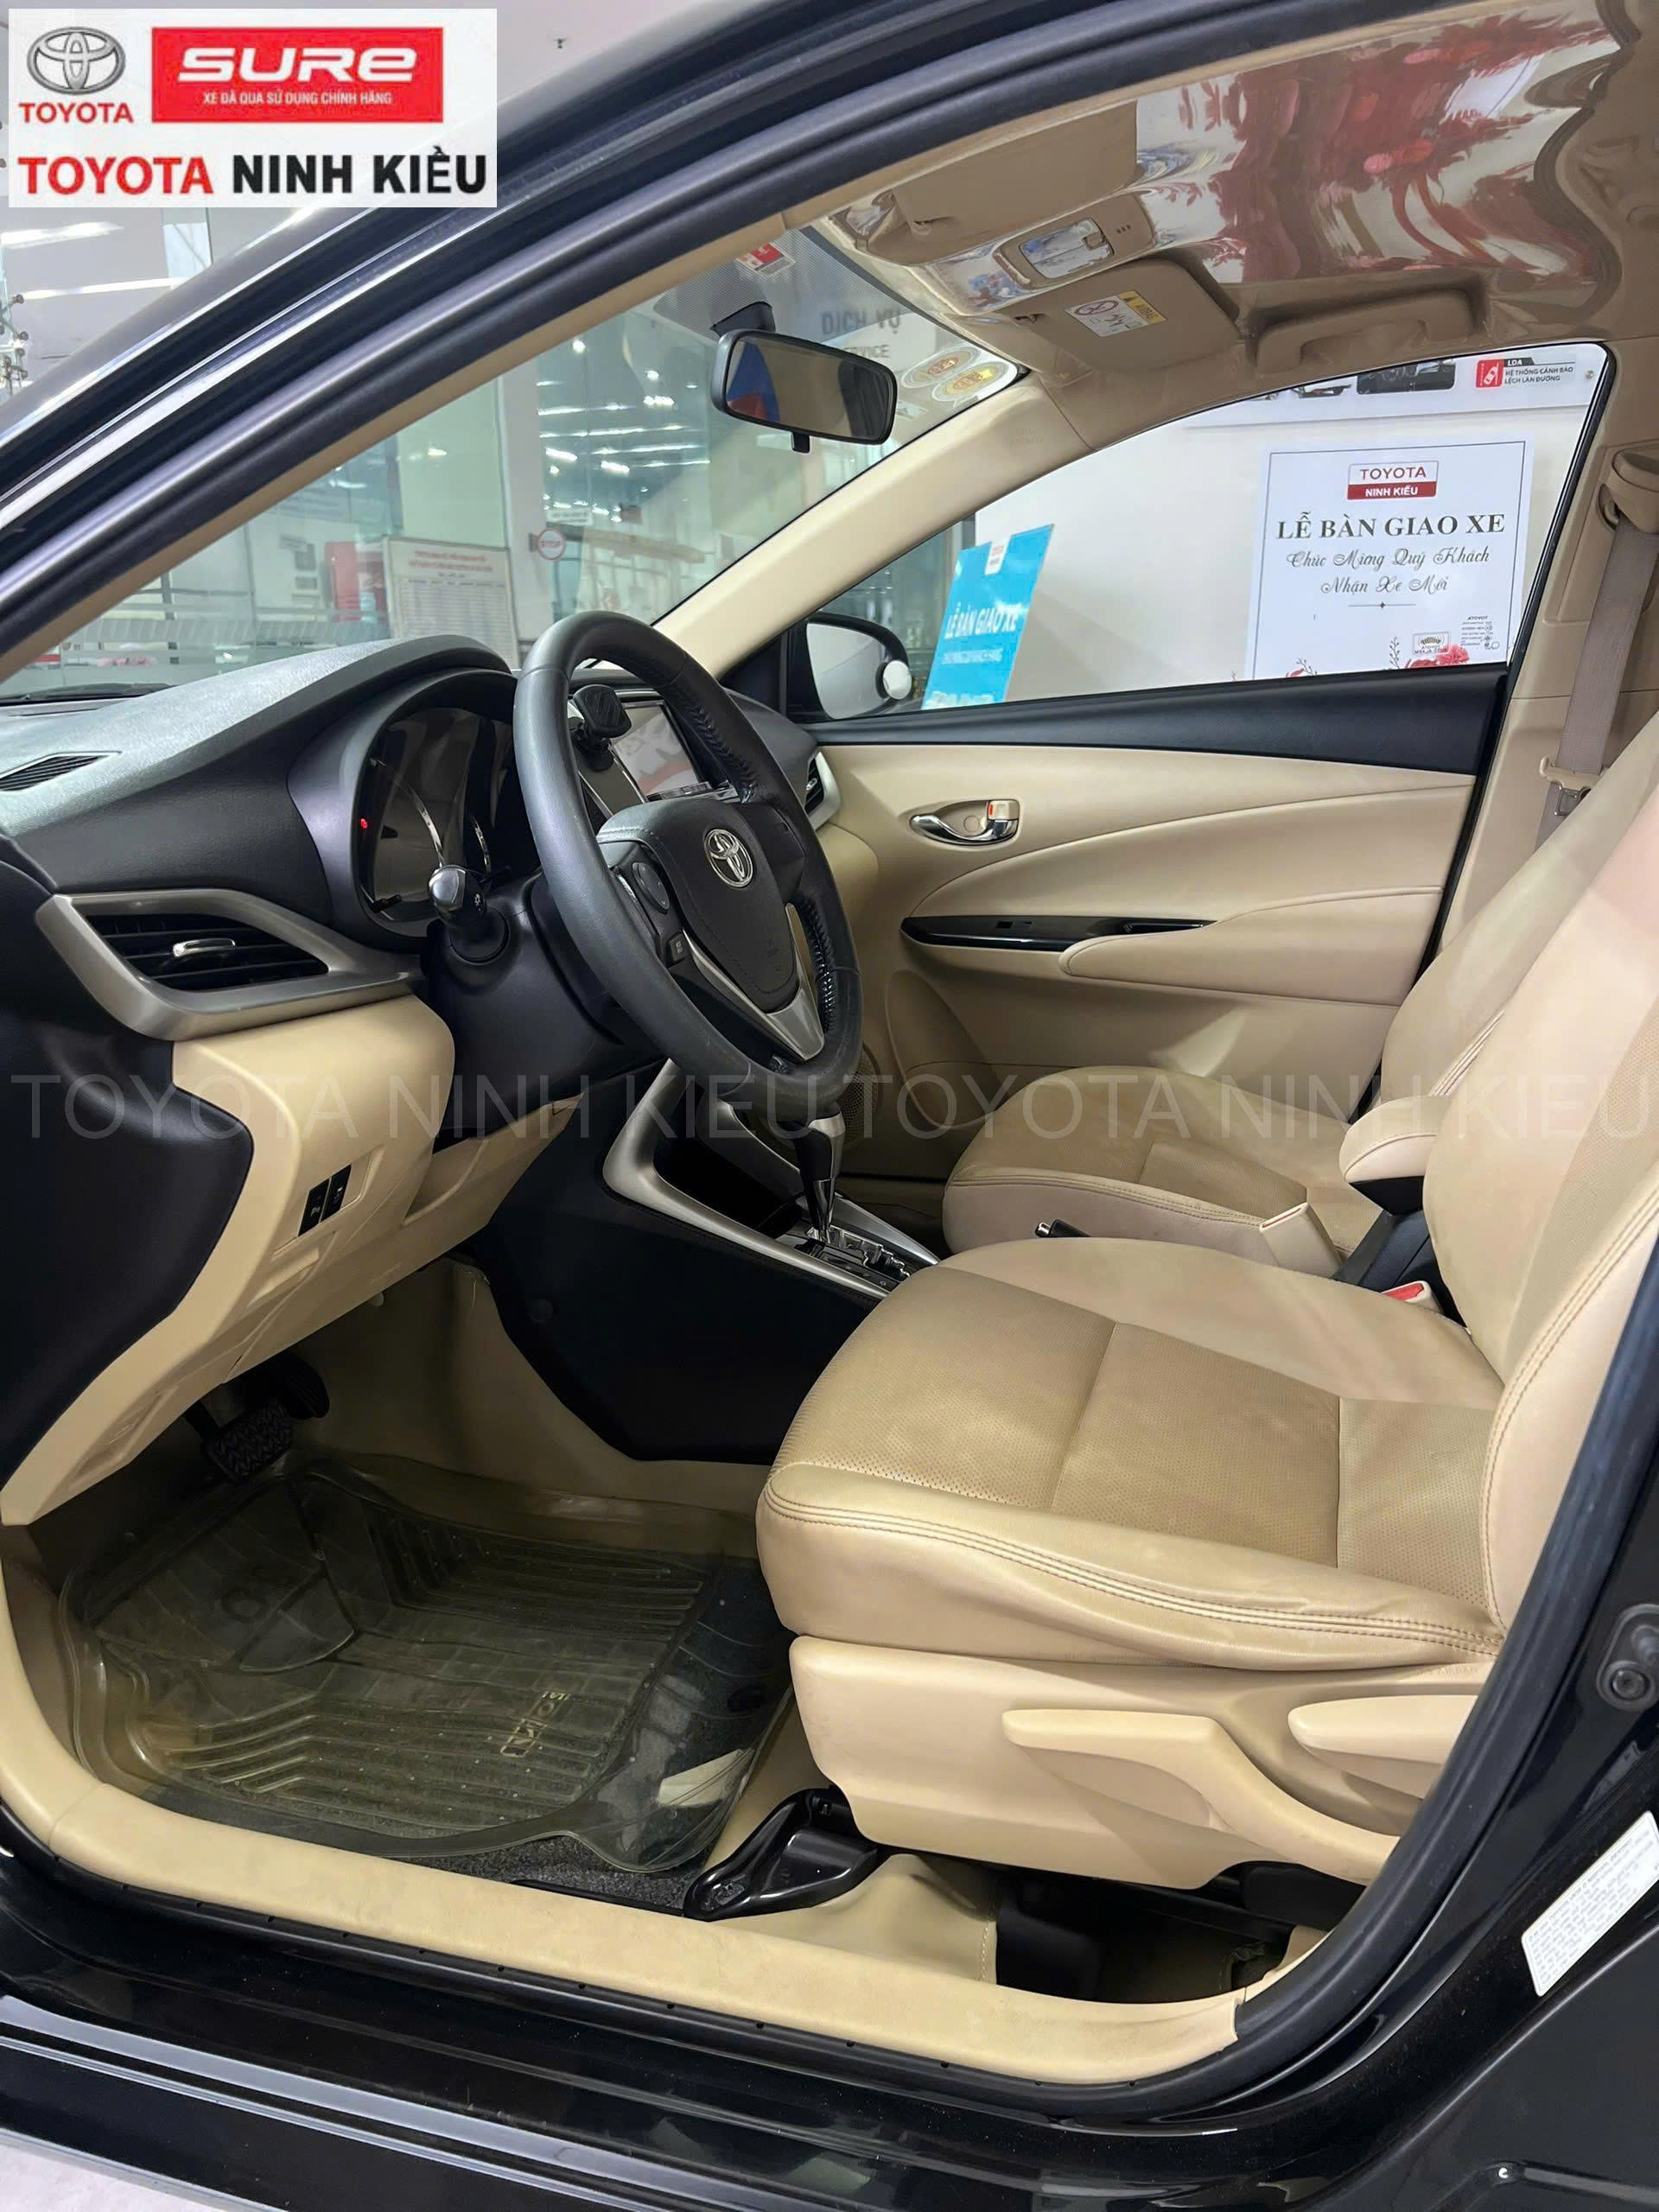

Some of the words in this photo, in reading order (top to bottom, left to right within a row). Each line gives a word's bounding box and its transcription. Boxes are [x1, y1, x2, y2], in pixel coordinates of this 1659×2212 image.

[1360, 467, 1427, 480] TOYOTA
[1365, 487, 1391, 498] NINH
[1276, 512, 1312, 540] LỄ
[1320, 514, 1376, 538] BÀN
[1384, 516, 1459, 537] GIAO
[1465, 514, 1506, 534] XE
[1287, 550, 1326, 568] Chúc
[1391, 548, 1426, 570] Quý
[1433, 546, 1491, 564] Khách
[1320, 576, 1369, 595] Nhận
[1376, 575, 1402, 593] Xe
